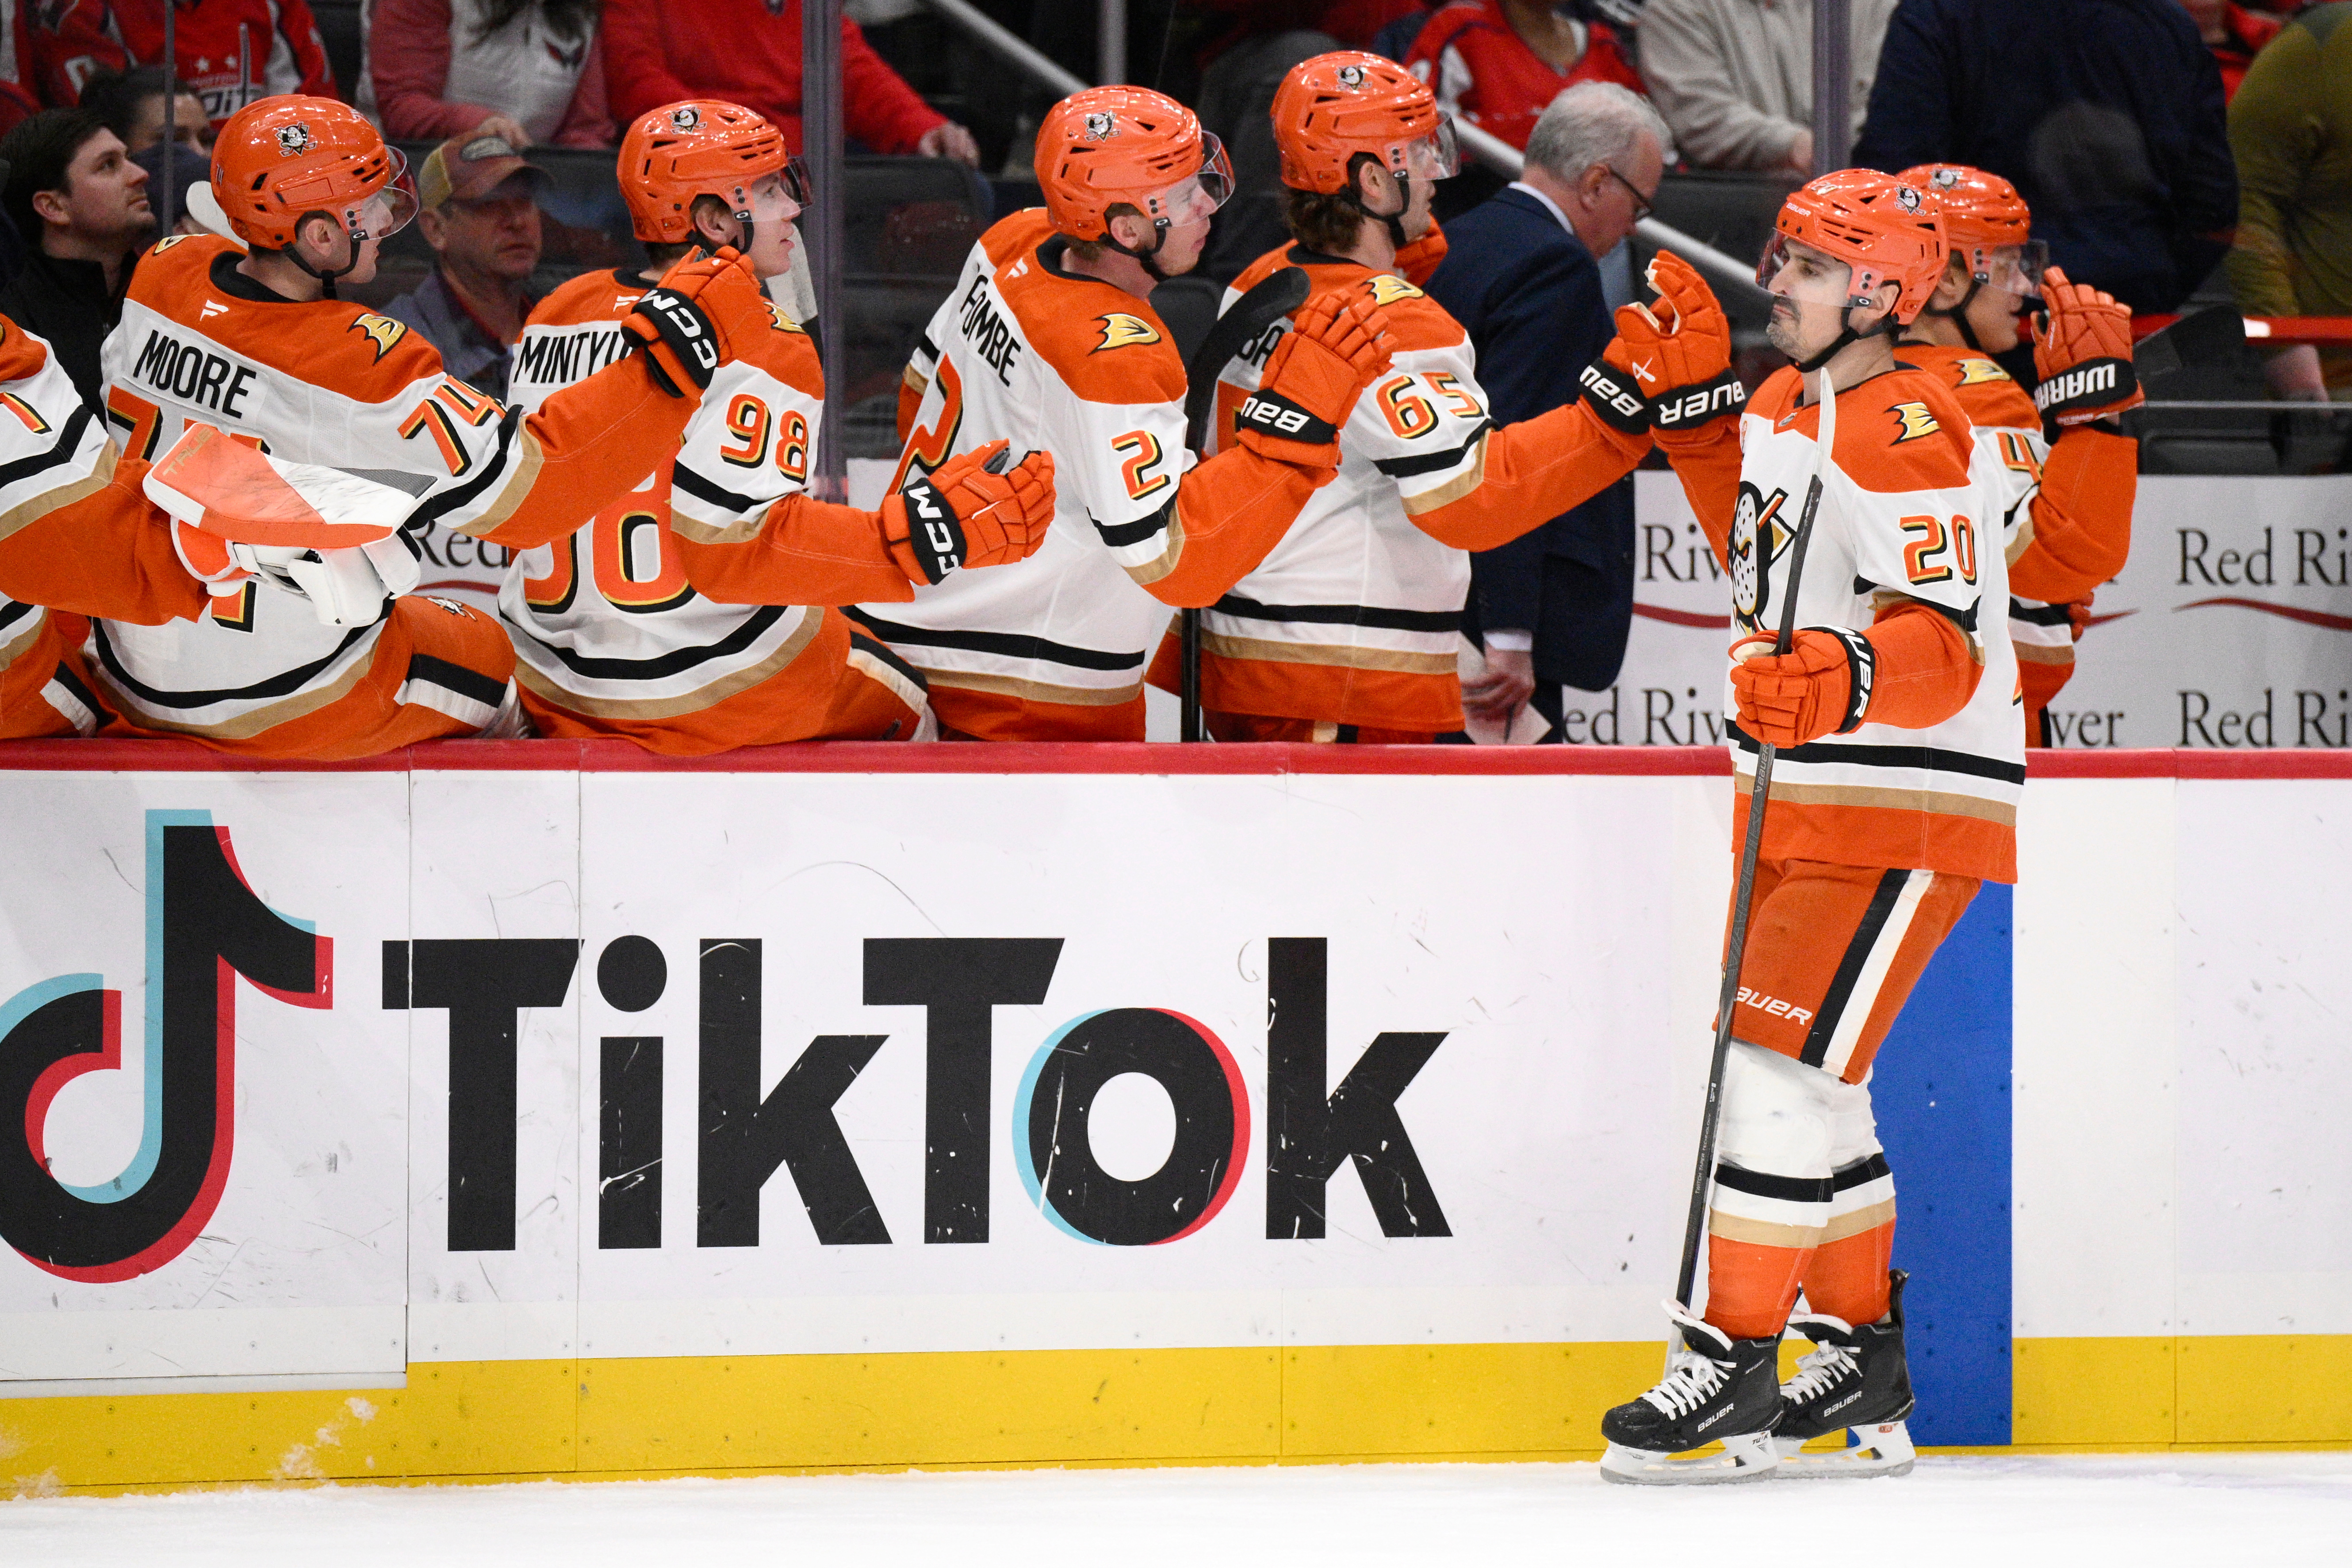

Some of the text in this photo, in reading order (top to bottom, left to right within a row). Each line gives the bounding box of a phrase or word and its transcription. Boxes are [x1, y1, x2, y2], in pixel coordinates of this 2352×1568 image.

[639, 289, 717, 369] CCM
[133, 329, 257, 419] MOORE
[1376, 372, 1485, 439] 65
[162, 426, 214, 476] TRUE
[397, 375, 507, 476] 74
[720, 393, 809, 485] 98
[1111, 430, 1171, 500] 2
[908, 485, 959, 575] CCM
[1900, 514, 1977, 586] 20
[2176, 525, 2276, 586] Red
[2176, 687, 2277, 748] Red
[380, 934, 1454, 1252] TikTok
[1697, 1403, 1734, 1433] BAUER
[1823, 1390, 1863, 1418] BAUER
